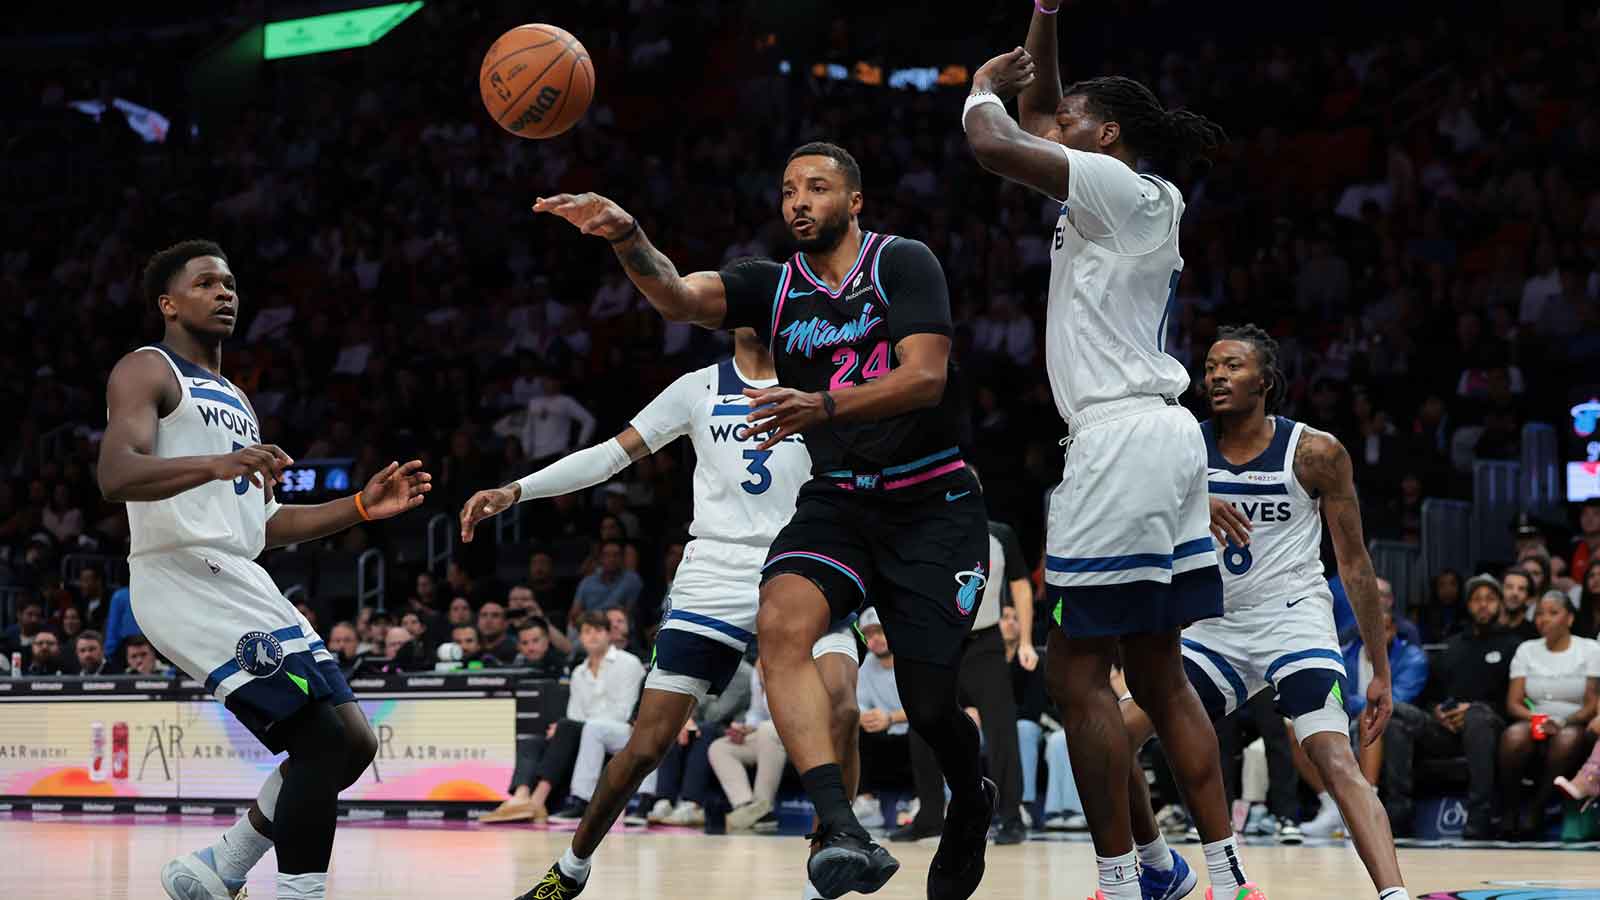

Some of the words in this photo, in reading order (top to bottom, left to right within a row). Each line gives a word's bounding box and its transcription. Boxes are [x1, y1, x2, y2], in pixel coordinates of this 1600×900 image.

[779, 302, 882, 358] Miami
[829, 340, 890, 391] 24
[197, 405, 260, 442] WOLVE
[741, 449, 773, 495] 3
